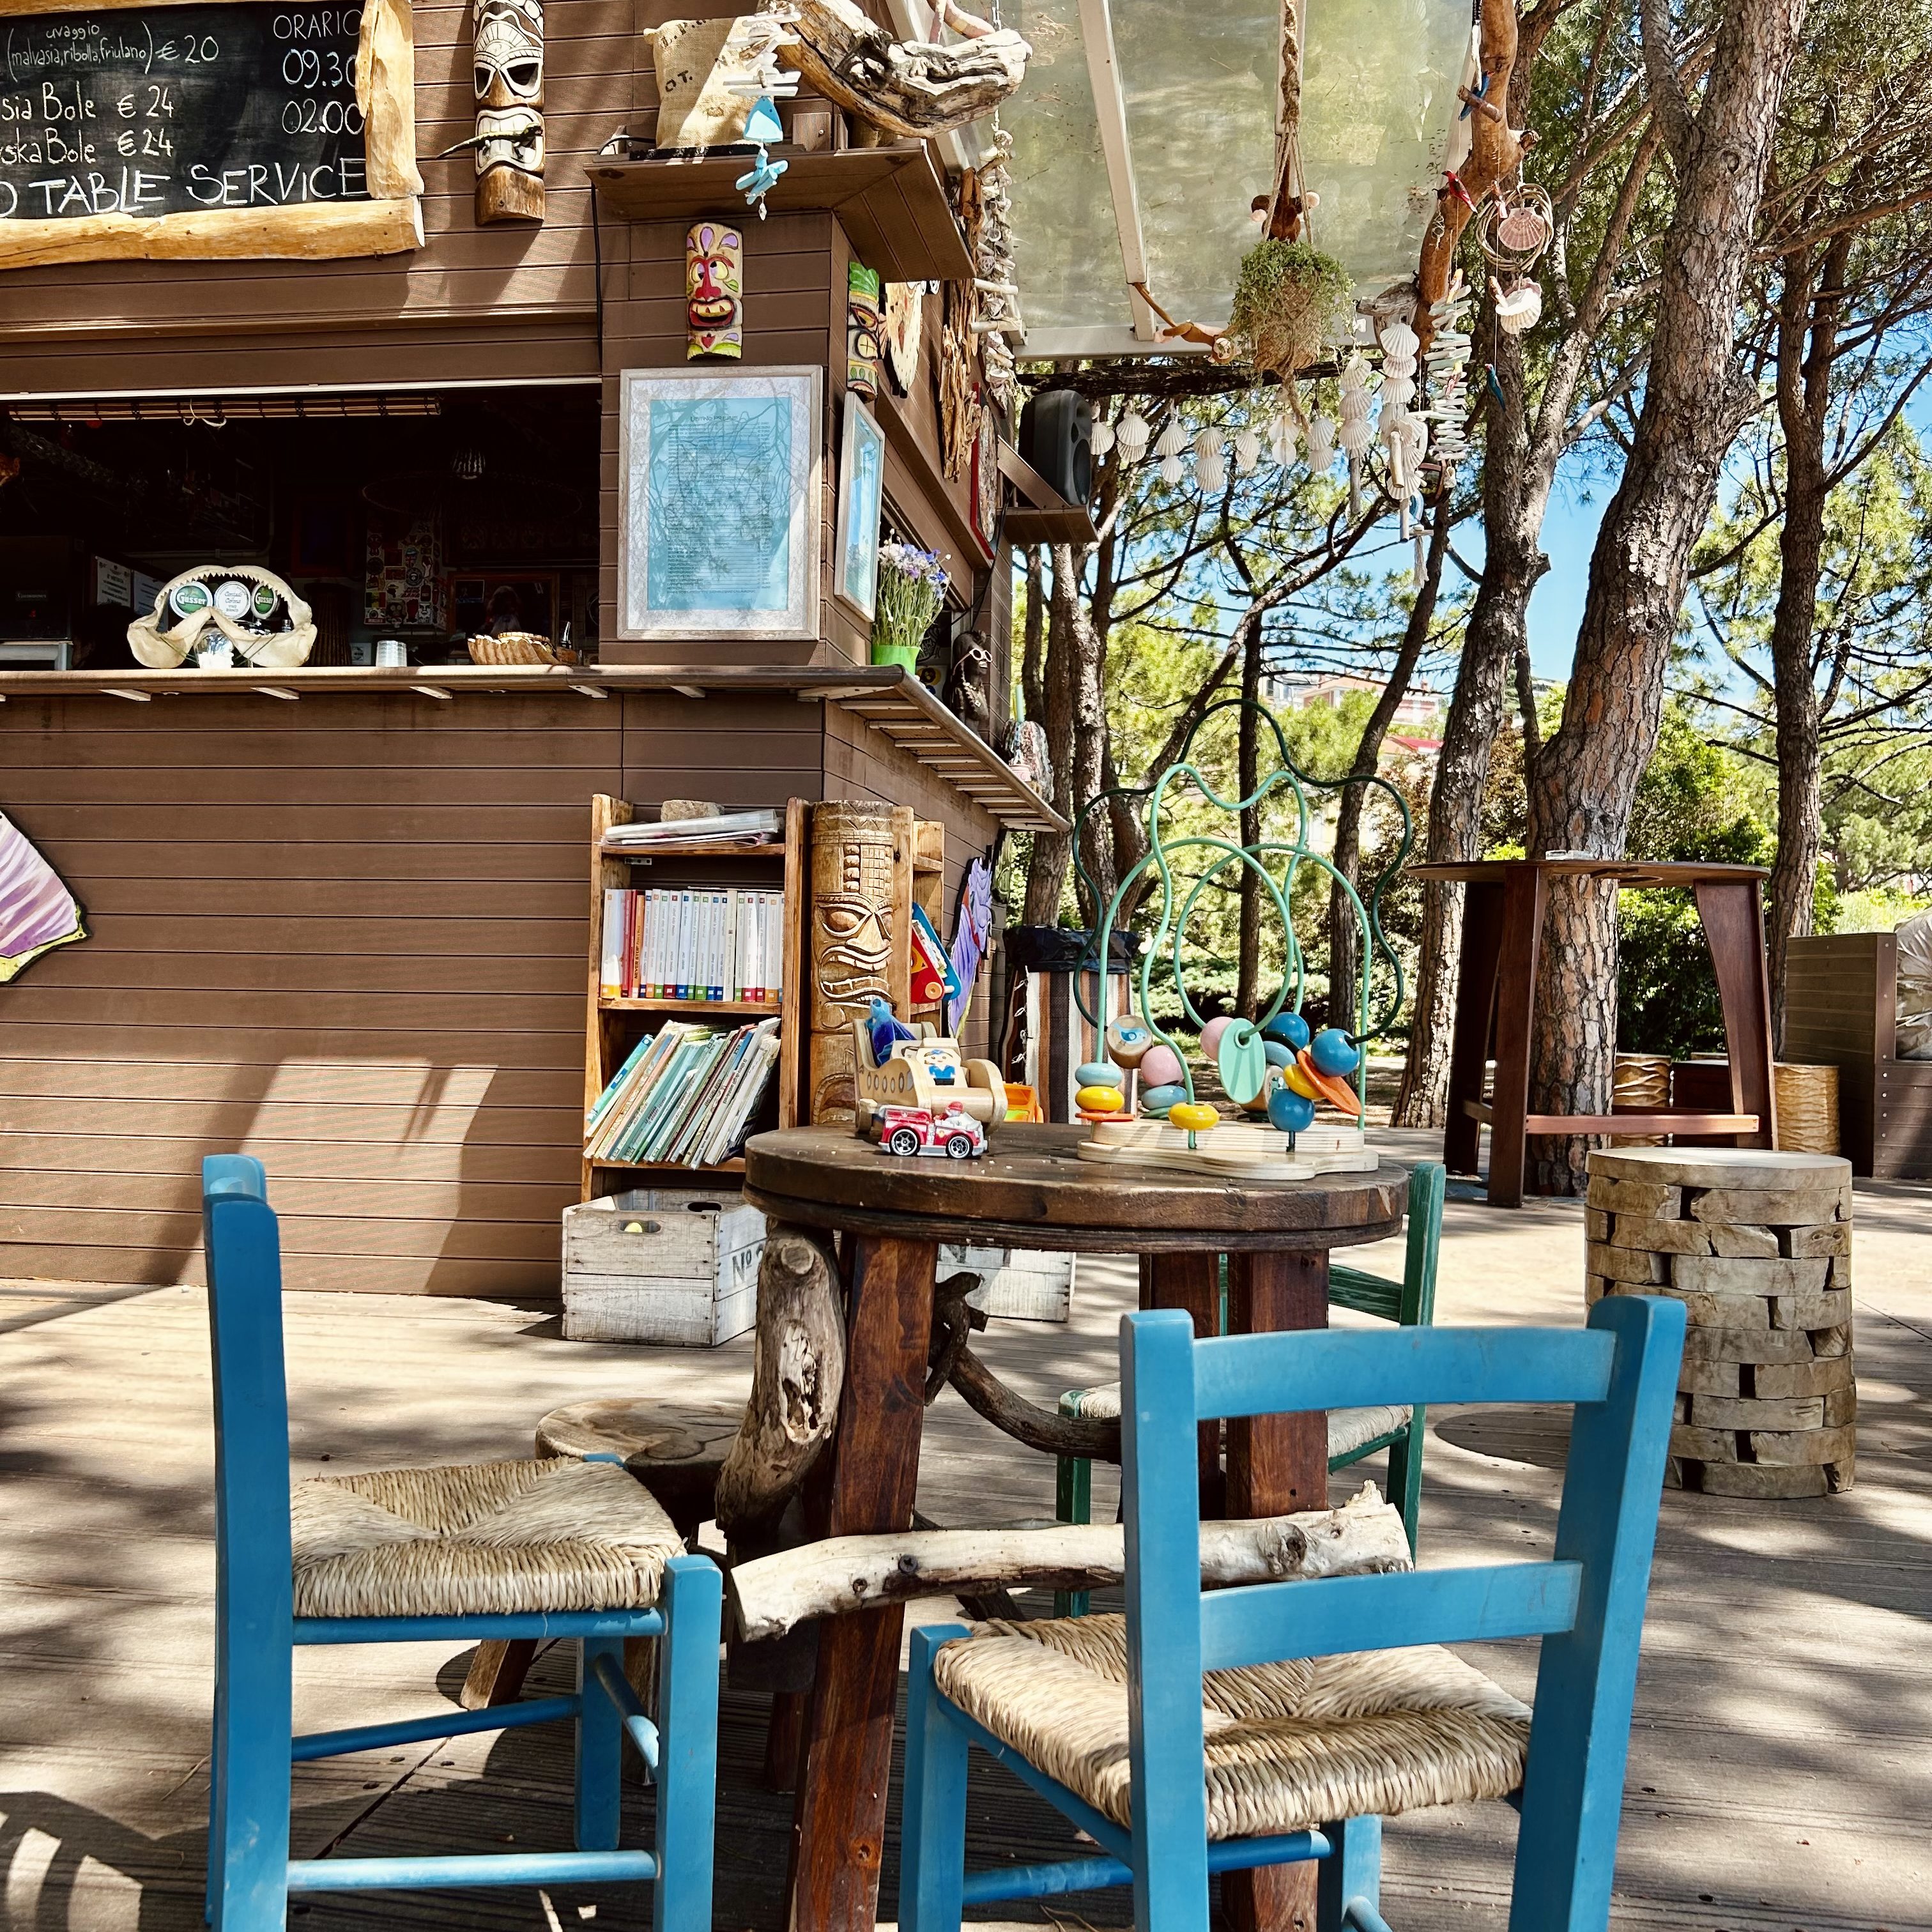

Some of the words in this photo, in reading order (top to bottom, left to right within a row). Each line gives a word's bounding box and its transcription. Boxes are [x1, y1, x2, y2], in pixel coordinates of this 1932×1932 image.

[46, 20, 100, 40] uvaggio
[273, 9, 362, 40] ORARIO
[184, 35, 219, 63] 20
[42, 80, 96, 121] Bole
[146, 85, 174, 118] 24
[282, 98, 365, 135] 02.00
[44, 128, 96, 164] Bole
[142, 128, 173, 157] 24
[29, 166, 171, 214] TABLE
[186, 158, 366, 205] SERVICE
